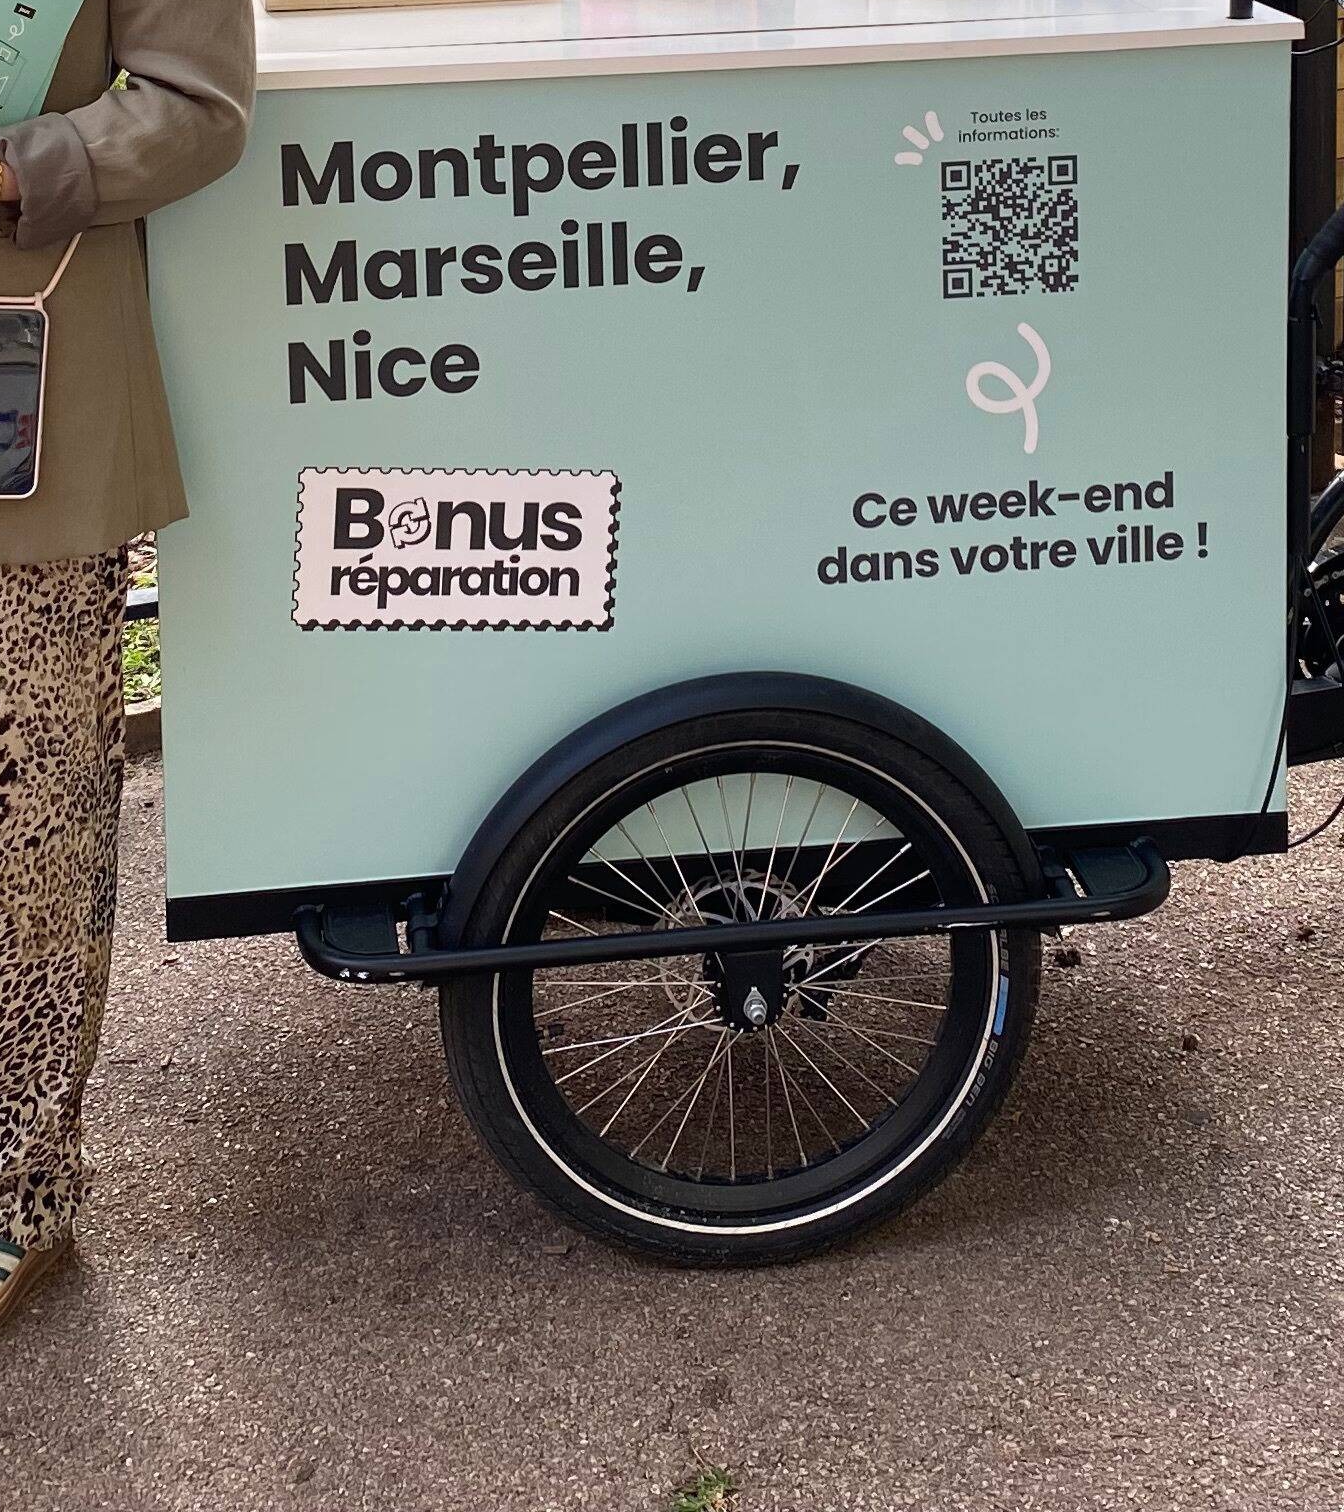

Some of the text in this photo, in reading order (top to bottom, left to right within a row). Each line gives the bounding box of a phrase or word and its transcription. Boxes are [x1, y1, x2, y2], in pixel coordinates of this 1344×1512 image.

[958, 126, 1060, 144] informations:
[970, 108, 1048, 124] Toutes les
[280, 115, 801, 217] Montpellier,
[283, 219, 706, 306] Marseille,
[287, 328, 480, 405] Nice
[852, 470, 1175, 528] Ce week-end
[330, 551, 580, 610] réparation
[816, 521, 1210, 586] dans votre ville !
[965, 1039, 1000, 1108] BIG BEN
